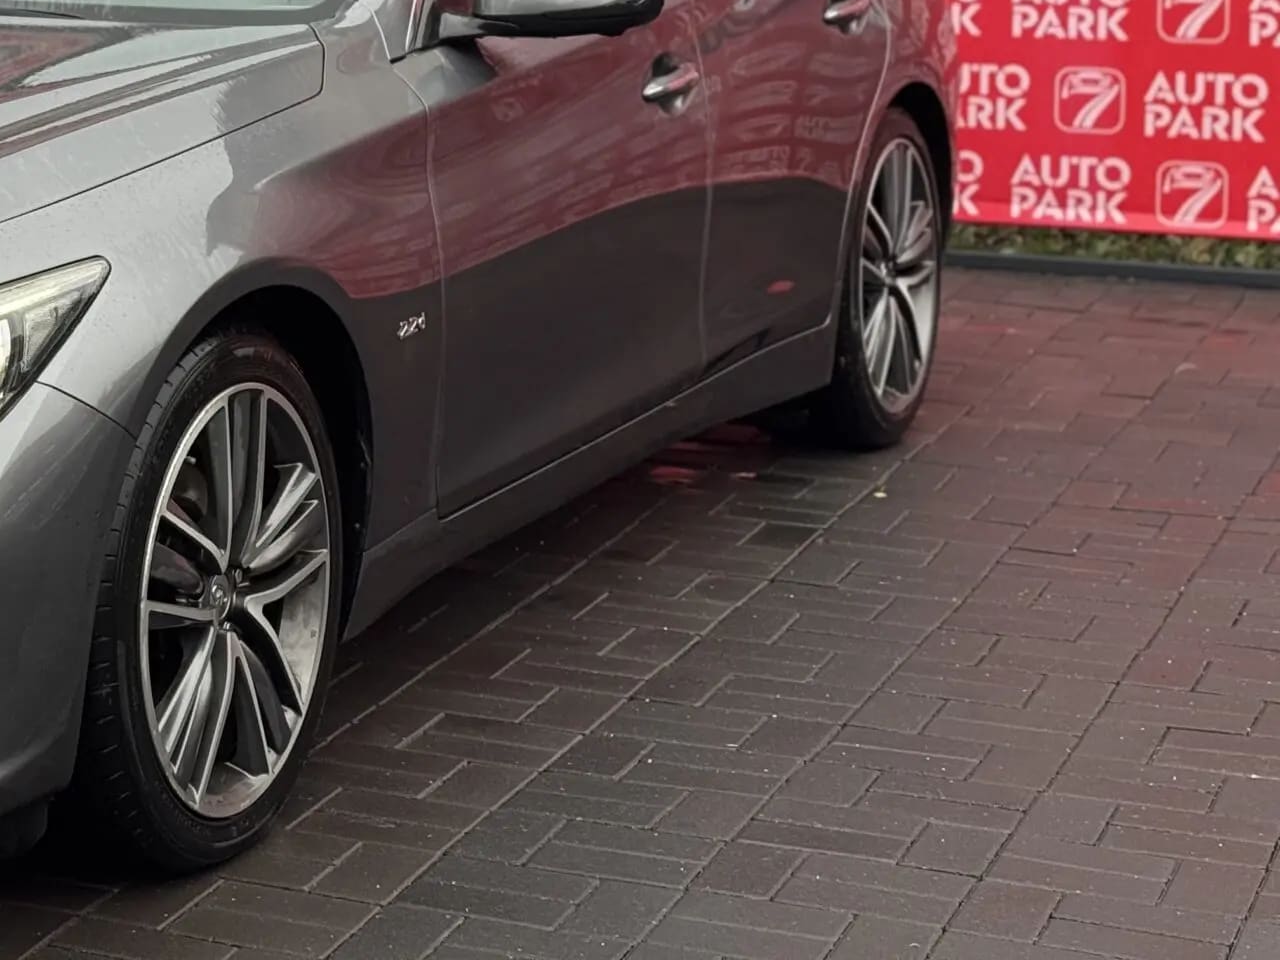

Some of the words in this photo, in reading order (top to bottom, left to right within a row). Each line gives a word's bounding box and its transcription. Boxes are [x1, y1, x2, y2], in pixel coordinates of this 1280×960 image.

[1012, 3, 1127, 41] PARK
[956, 63, 1031, 97] UTO
[1144, 72, 1268, 107] AUTO
[1145, 103, 1264, 142] PARK
[1011, 155, 1131, 191] AUTO
[1010, 185, 1128, 226] PARK
